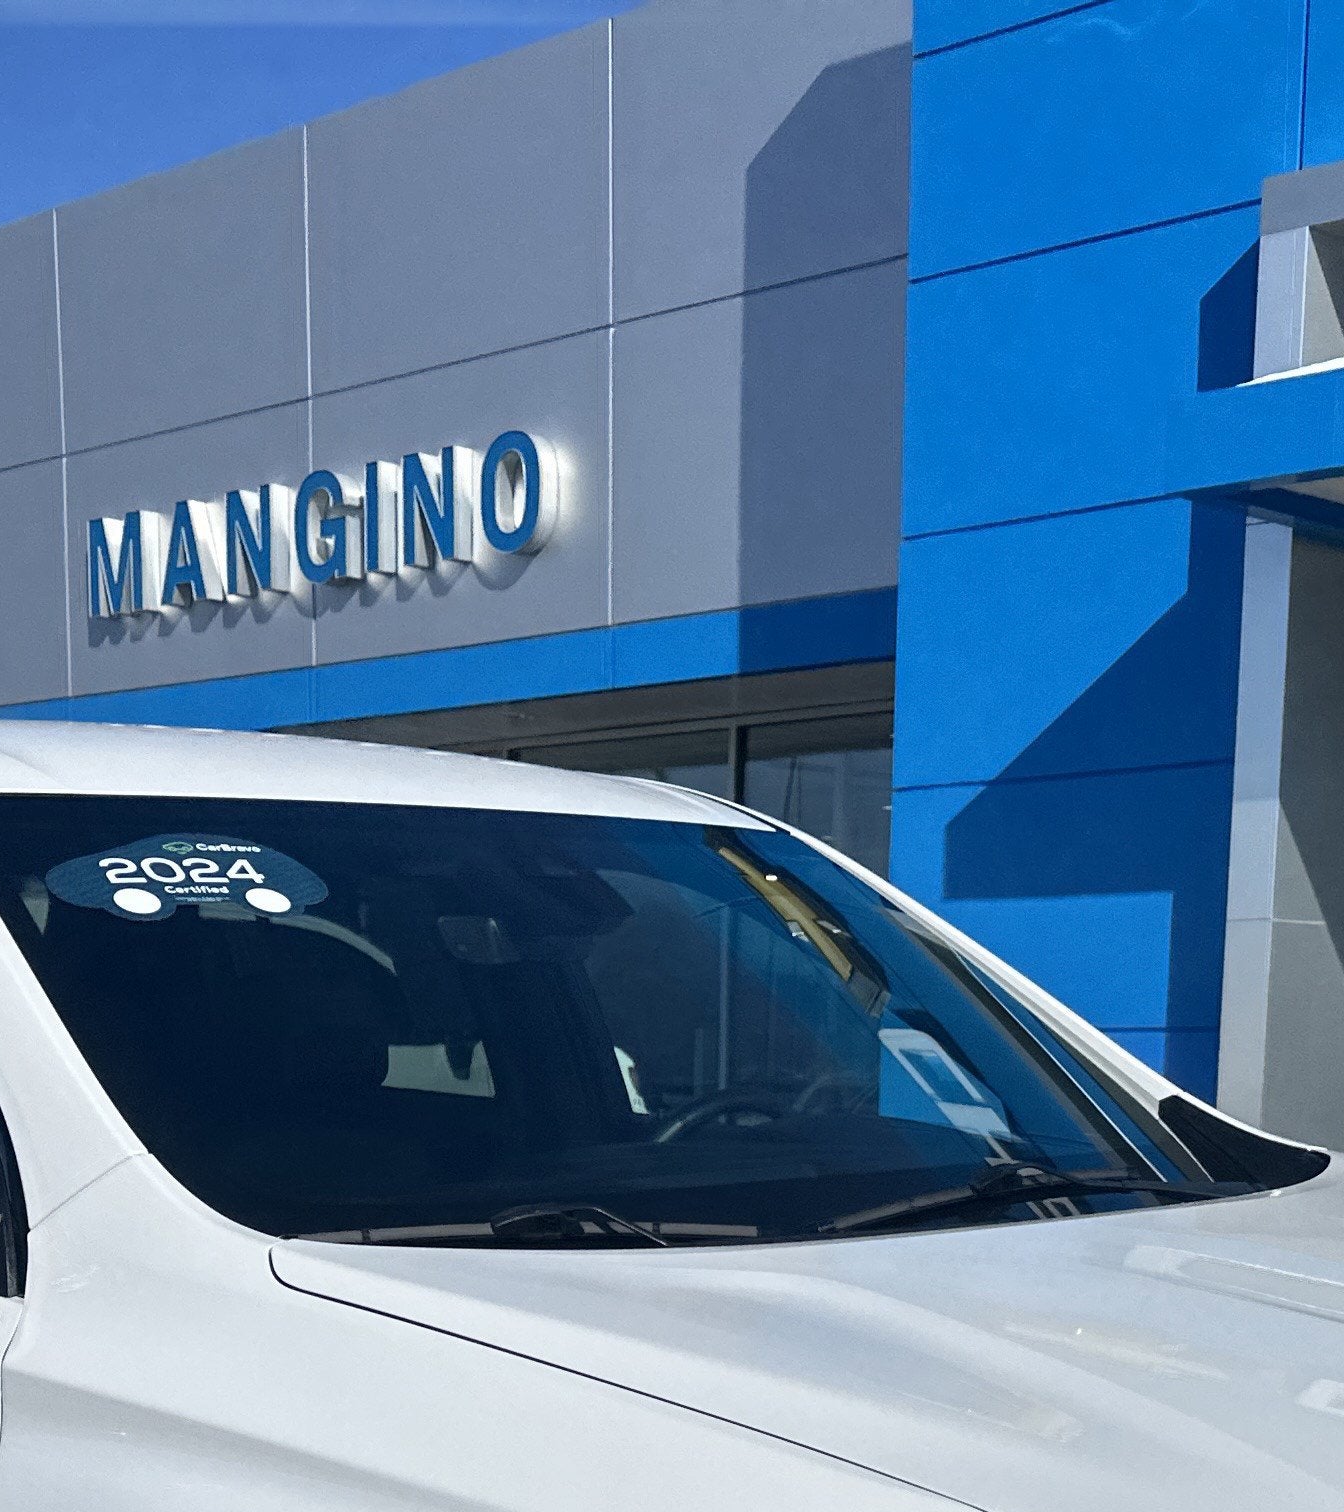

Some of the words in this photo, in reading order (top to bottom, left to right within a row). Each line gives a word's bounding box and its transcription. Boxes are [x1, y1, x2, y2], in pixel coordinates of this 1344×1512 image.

[86, 430, 548, 619] MANGINO
[98, 856, 266, 884] 2024
[163, 885, 230, 894] Certified
